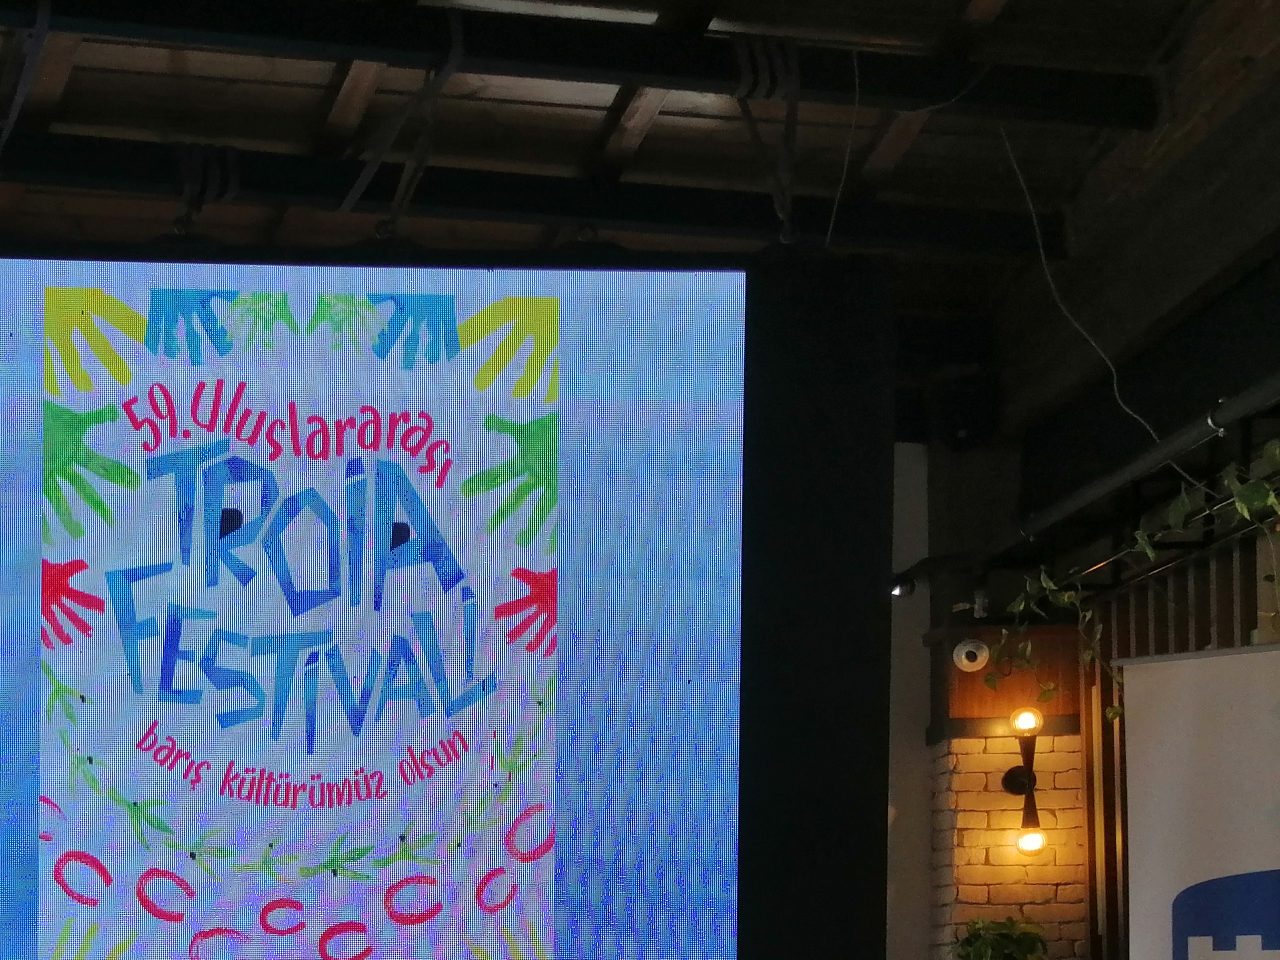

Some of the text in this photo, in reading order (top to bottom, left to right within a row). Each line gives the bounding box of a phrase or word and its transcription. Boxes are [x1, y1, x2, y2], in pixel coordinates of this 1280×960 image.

[136, 719, 469, 809] barış kültürümüz olsun
